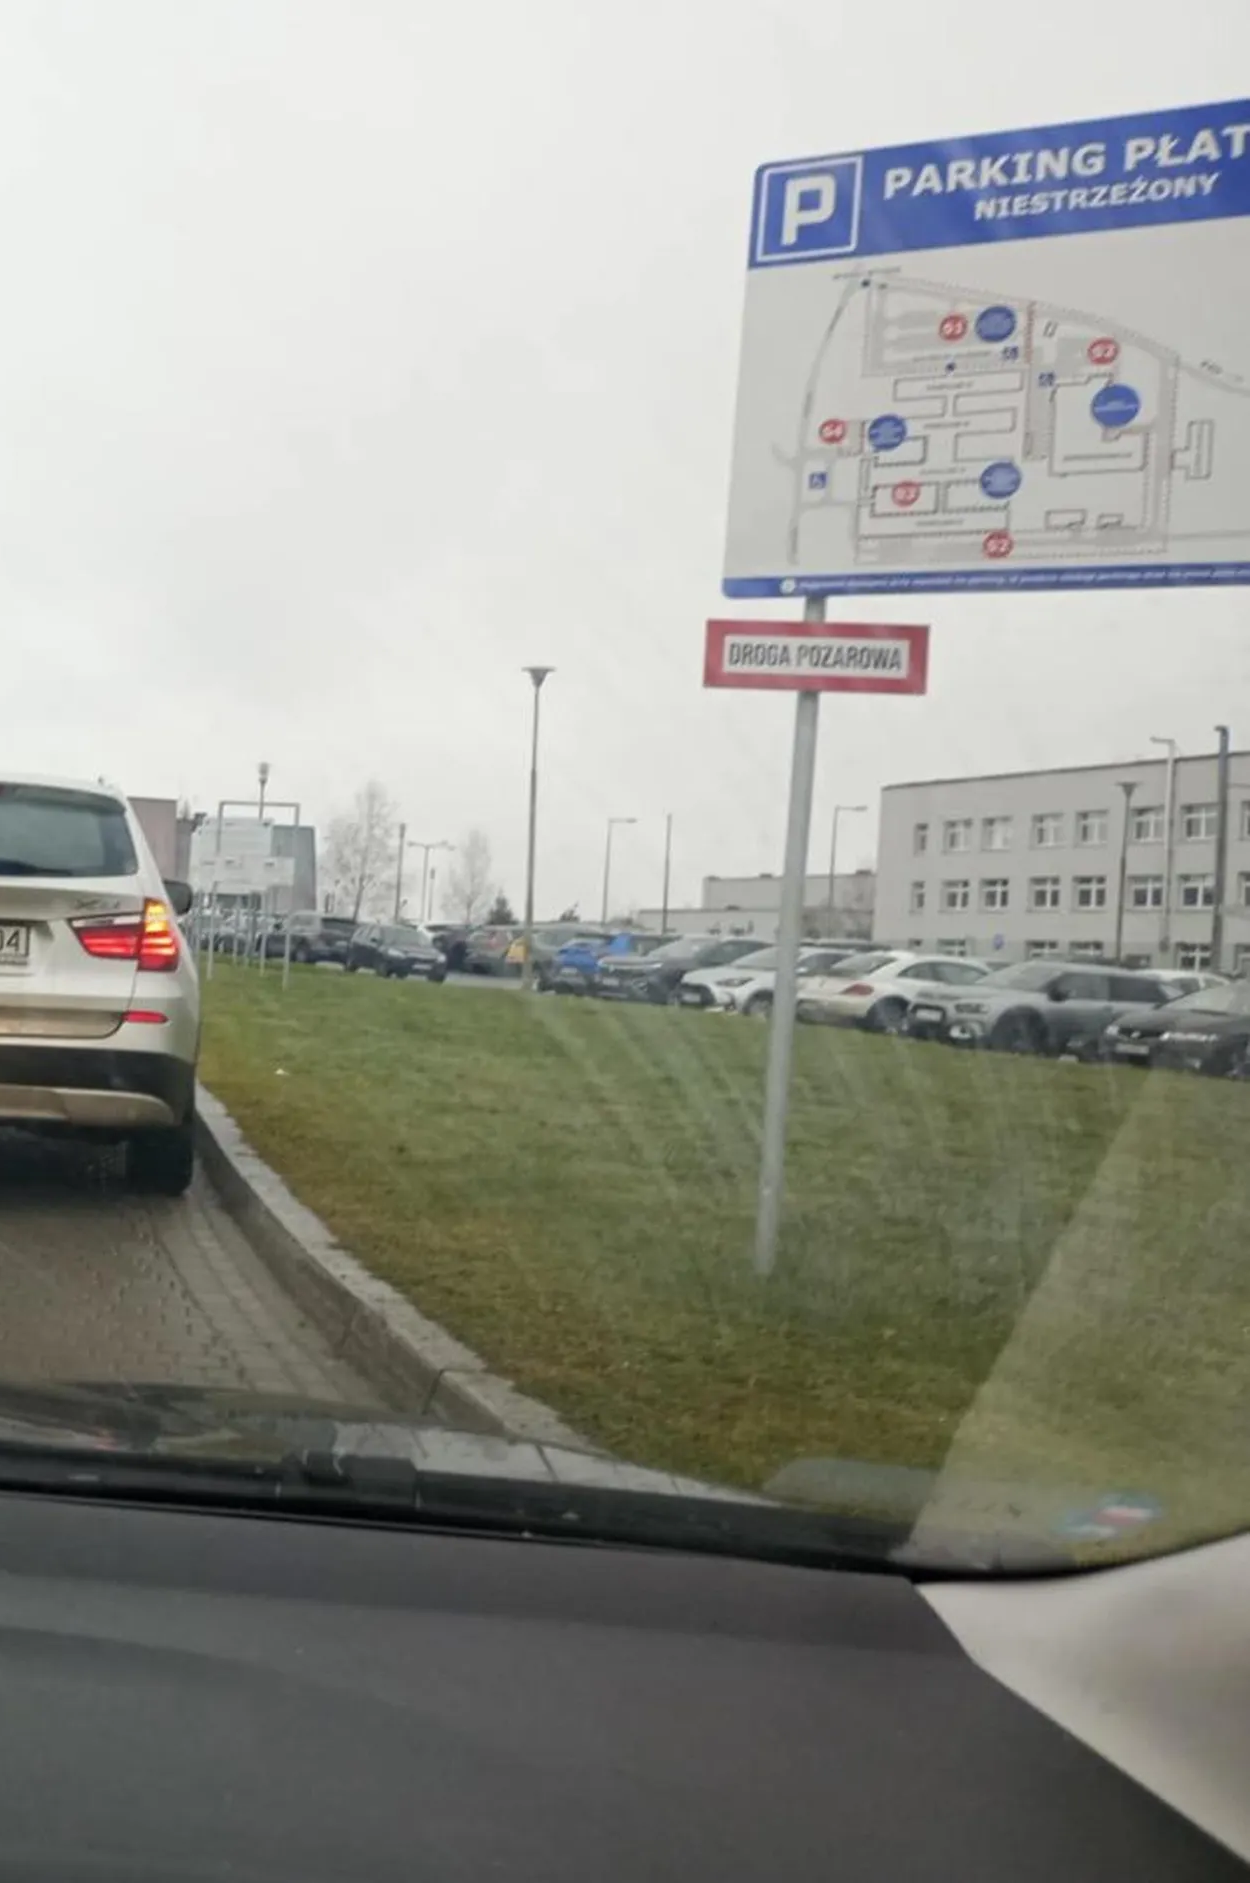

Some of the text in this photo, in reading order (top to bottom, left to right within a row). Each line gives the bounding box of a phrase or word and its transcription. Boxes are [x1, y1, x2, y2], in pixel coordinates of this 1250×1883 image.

[883, 142, 1106, 200] PARKING
[974, 172, 1221, 221] NIESTRZEŻONY
[781, 174, 836, 245] P
[728, 642, 791, 666] DROGA
